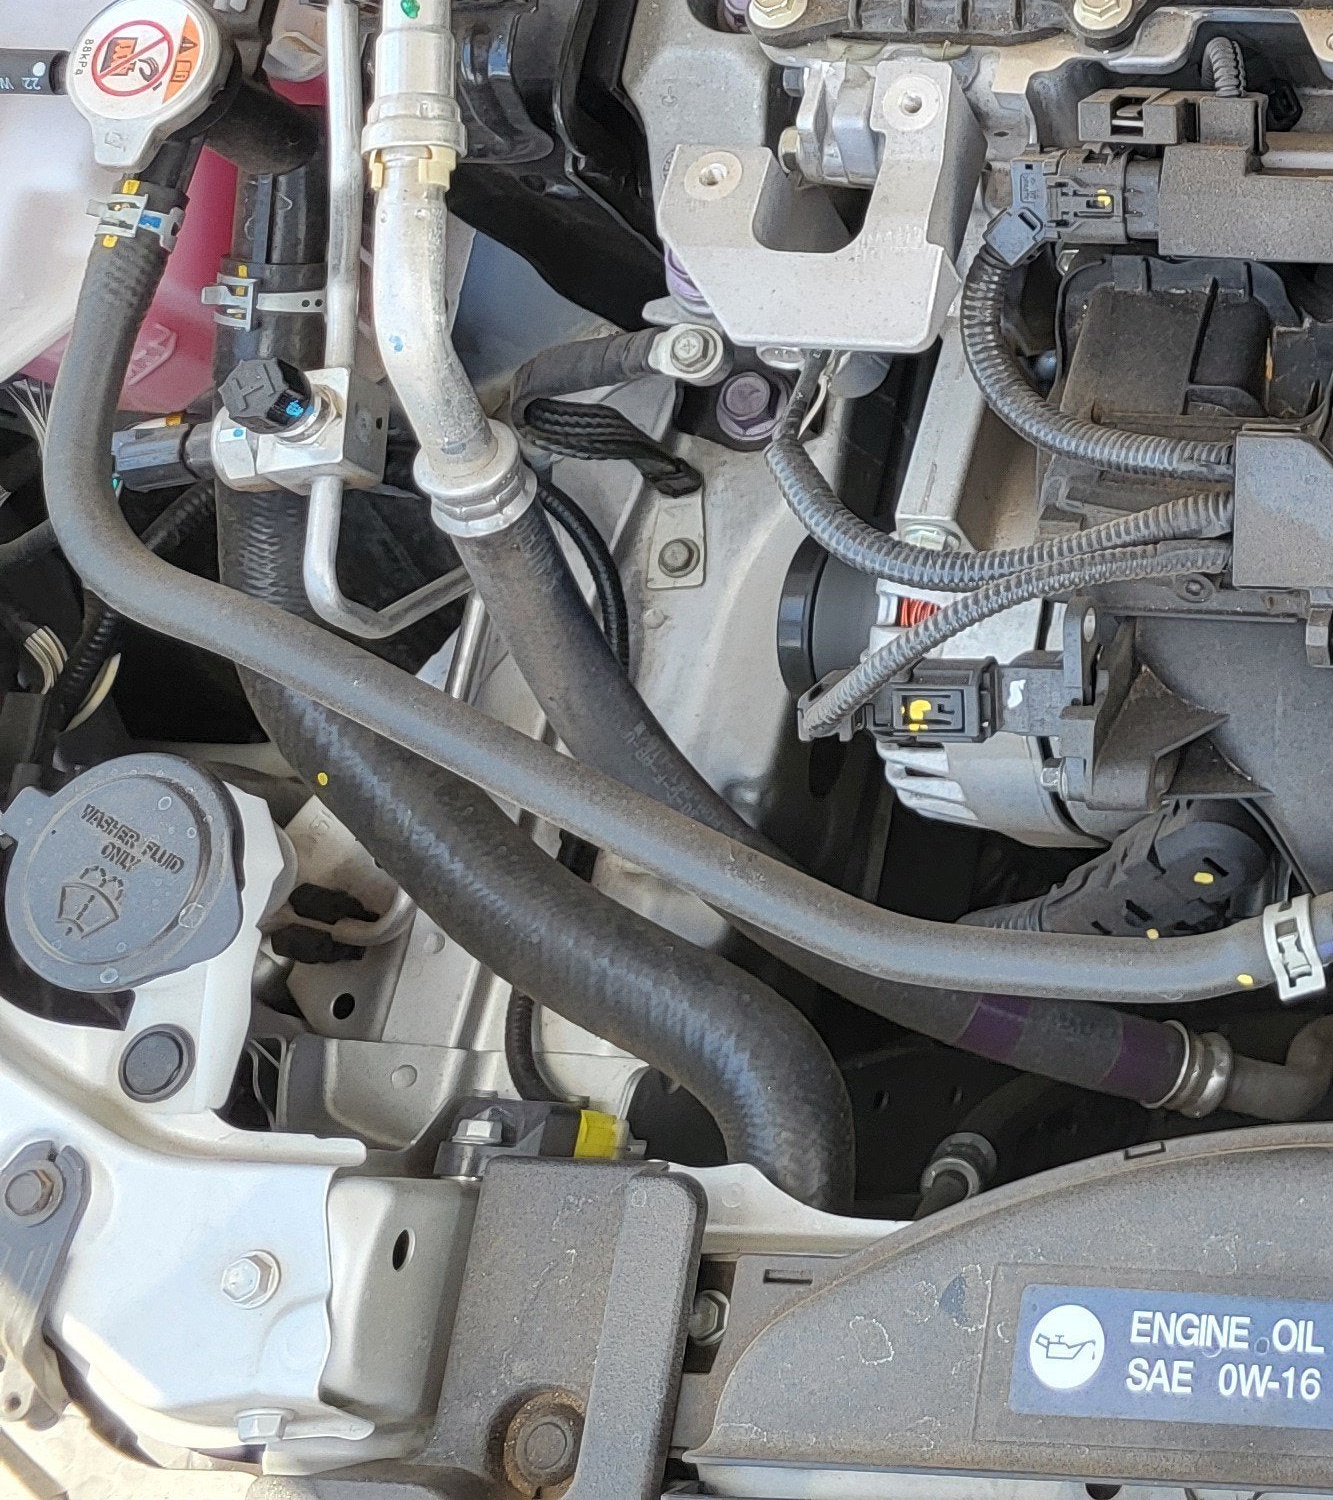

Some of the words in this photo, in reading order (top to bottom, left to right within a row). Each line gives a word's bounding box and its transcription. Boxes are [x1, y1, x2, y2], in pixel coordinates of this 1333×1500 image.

[74, 38, 95, 76] 88kPa
[80, 803, 141, 850] WASHER
[141, 840, 186, 875] FLUID
[101, 841, 143, 873] ONLY
[1129, 1309, 1251, 1350] ENGINE
[1271, 1318, 1325, 1355] OIL
[1125, 1356, 1194, 1395] SAE
[1217, 1362, 1323, 1401] 0W-16
